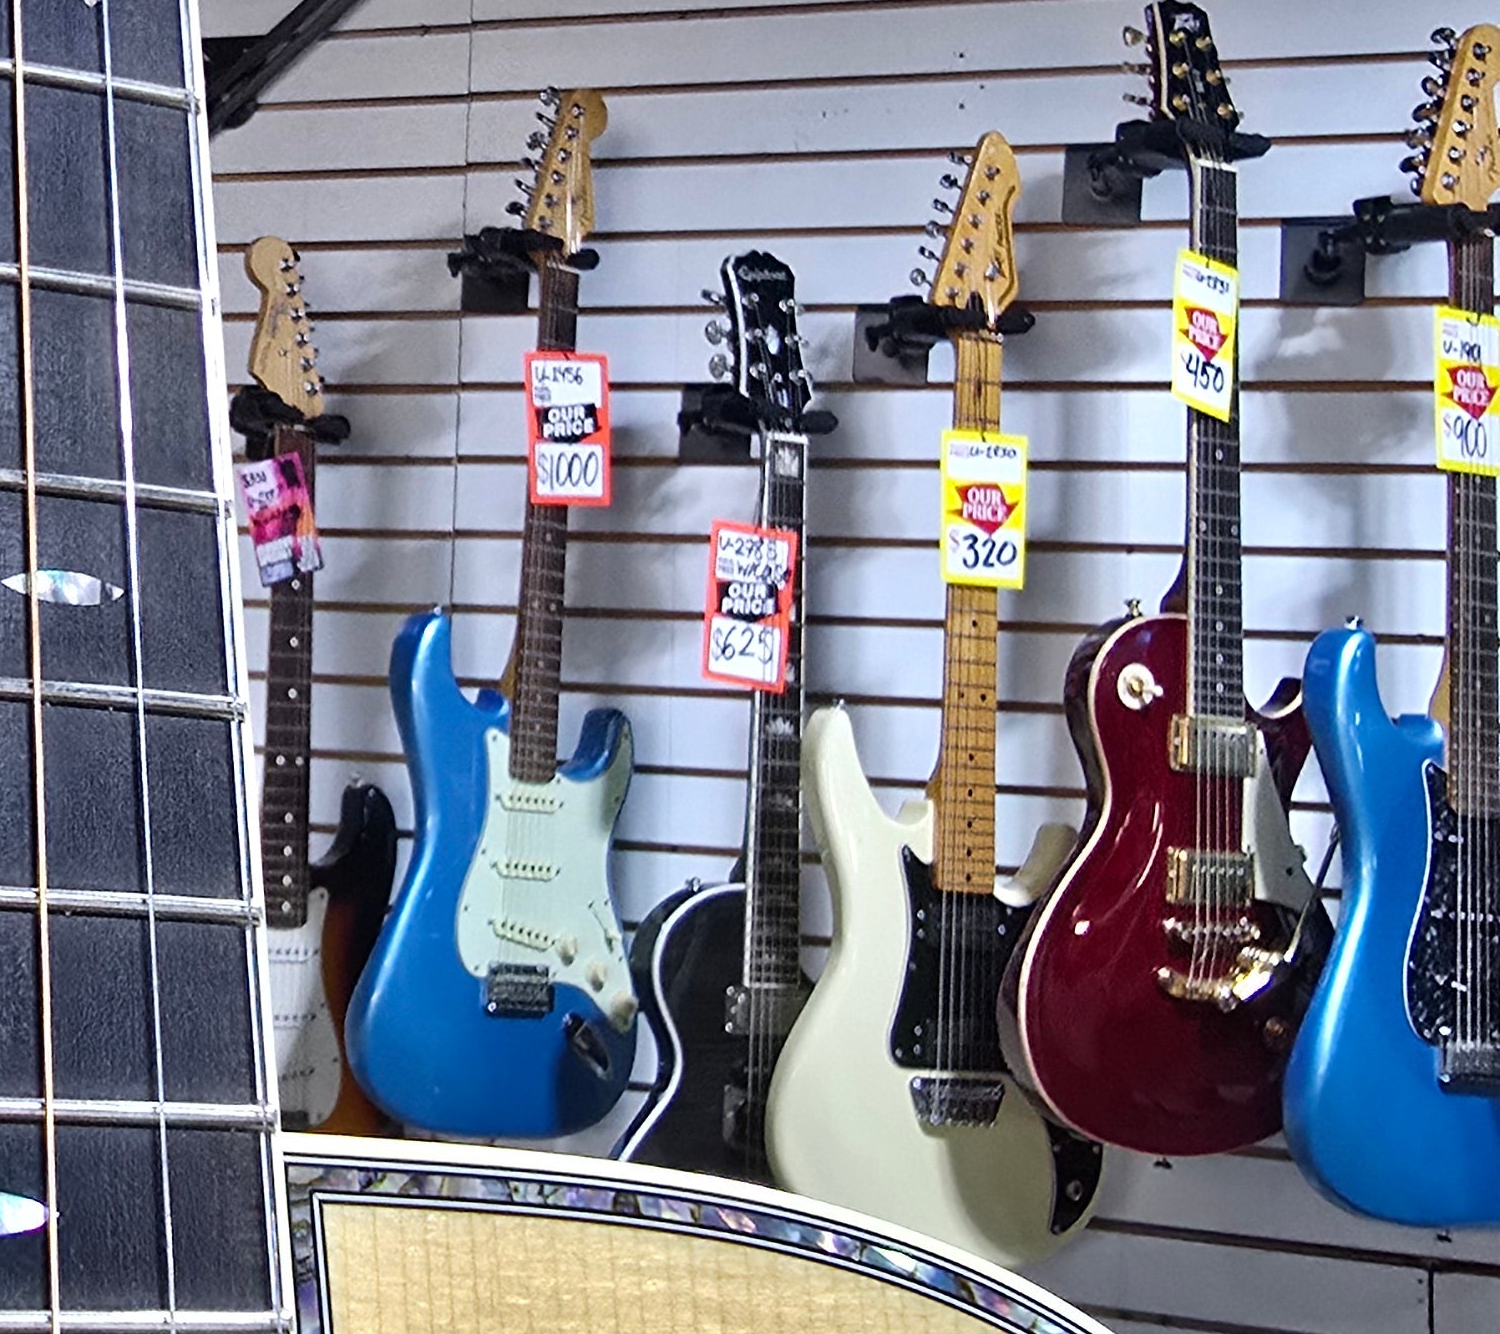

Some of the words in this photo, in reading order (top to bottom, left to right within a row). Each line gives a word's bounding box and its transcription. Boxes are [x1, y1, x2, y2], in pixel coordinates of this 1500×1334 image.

[1456, 369, 1486, 390] OUR
[547, 408, 586, 423] OUR
[543, 418, 595, 438] PRICE
[967, 486, 1002, 506] OUR
[962, 501, 1008, 523] PRICE
[728, 582, 767, 599] OUR
[721, 596, 776, 615] PRICE
